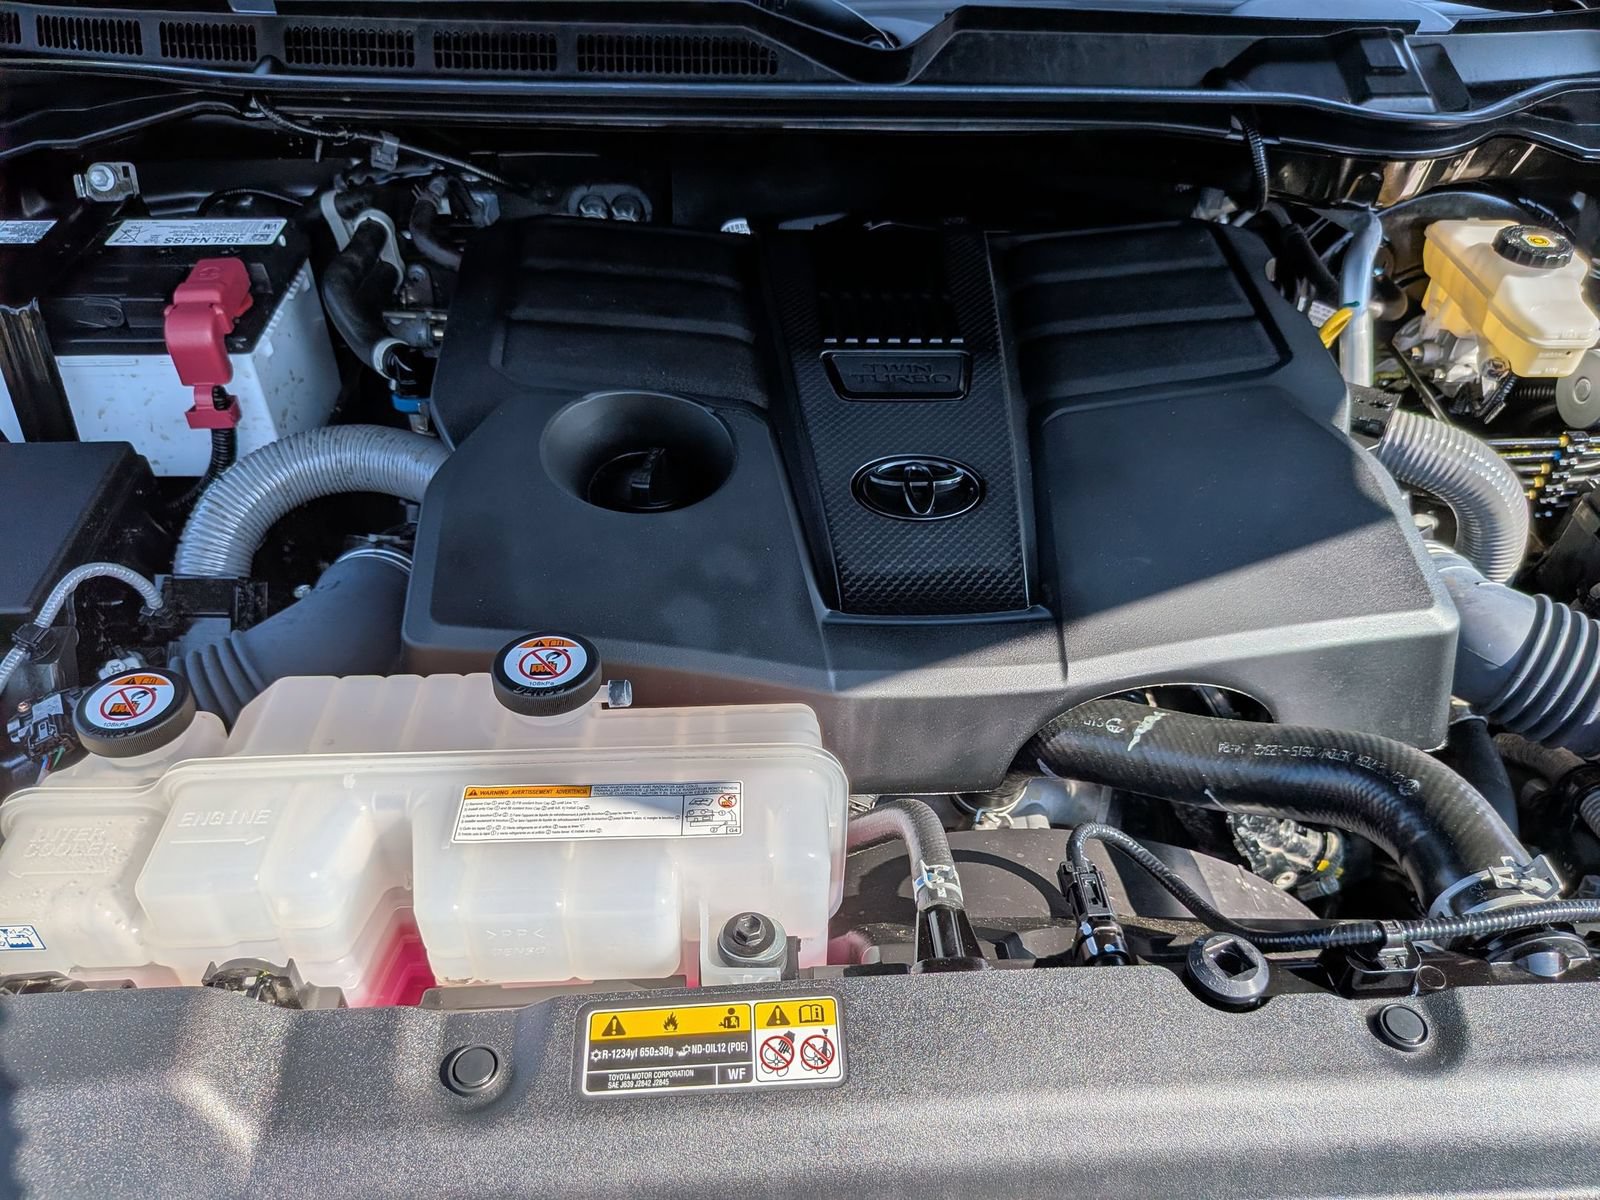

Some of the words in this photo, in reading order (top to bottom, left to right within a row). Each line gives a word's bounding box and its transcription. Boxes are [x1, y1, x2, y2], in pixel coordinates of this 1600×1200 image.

[863, 362, 932, 373] TWIN
[851, 374, 952, 385] TURBO
[177, 810, 272, 828] ENGINE
[24, 841, 116, 858] COOLER
[602, 1048, 638, 1060] R-1234yf
[640, 1046, 674, 1058] 650±30g
[691, 1043, 726, 1054] ND-OIL12
[728, 1042, 749, 1054] (POE)
[608, 1073, 631, 1081] TOYOTA
[632, 1072, 653, 1080] MOTOR
[653, 1069, 694, 1079] CORPORATION
[728, 1068, 746, 1080] WF
